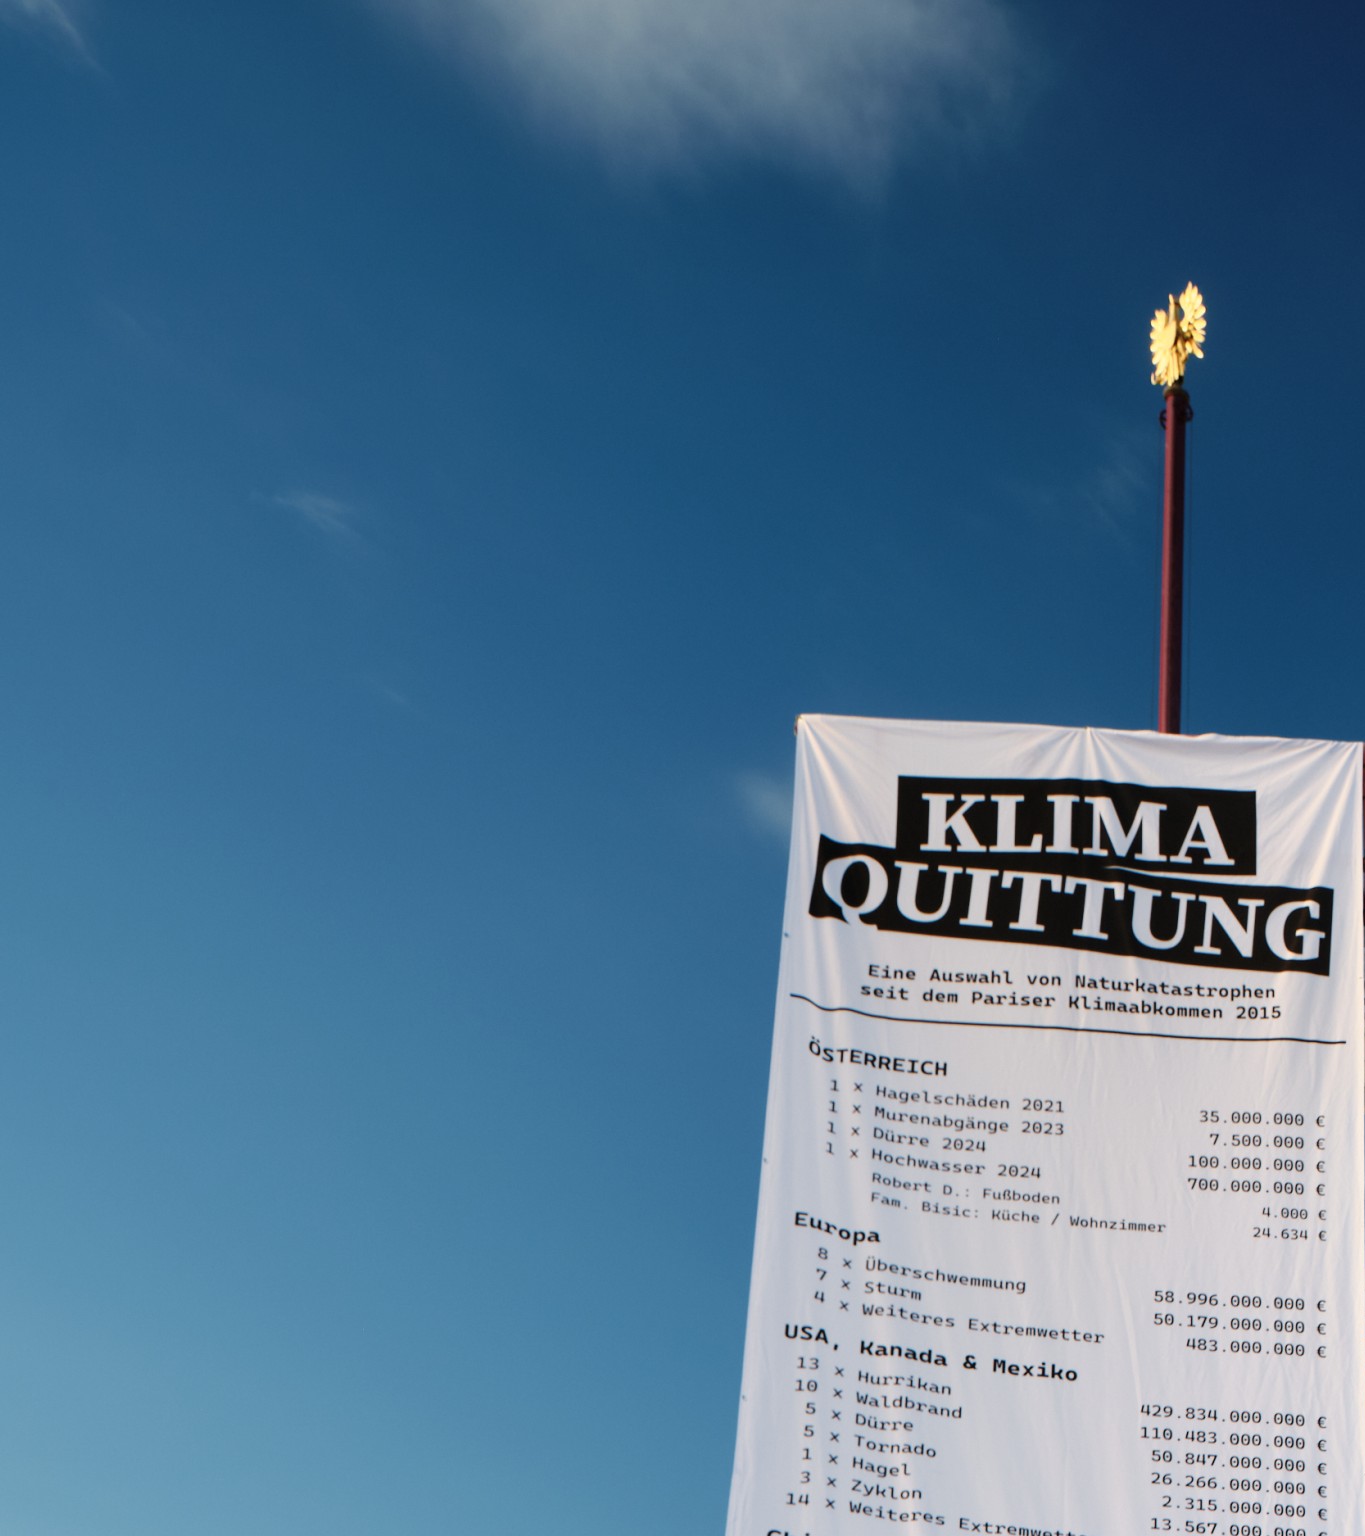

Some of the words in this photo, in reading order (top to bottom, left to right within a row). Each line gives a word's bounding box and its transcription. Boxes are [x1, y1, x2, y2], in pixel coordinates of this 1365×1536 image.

[920, 793, 1235, 866] KLIMA
[821, 853, 1327, 962] QUITTUNG
[867, 963, 917, 981] Eine
[929, 968, 1013, 985] Auswahl
[1026, 974, 1062, 987] von
[1074, 974, 1276, 1000] Naturkatastrophen
[859, 984, 911, 1003] seit
[921, 988, 959, 1004] dem
[971, 990, 1056, 1008] Pariser
[1068, 994, 1223, 1019] Klimaabkommen
[1235, 1005, 1282, 1020] 2015
[808, 1036, 948, 1077] ÖSTERREICH
[830, 1078, 839, 1093] 1
[875, 1084, 1010, 1110] Hagelschäden
[1021, 1097, 1065, 1114] 2021
[829, 1100, 838, 1114] 1
[873, 1105, 1010, 1135] Murenabgänge
[1021, 1120, 1065, 1136] 2023
[1199, 1109, 1305, 1127] 35.000.000
[1315, 1114, 1325, 1128] €
[827, 1121, 836, 1135] 1
[872, 1126, 930, 1148] Dürre
[942, 1137, 987, 1153] 2024
[1209, 1132, 1305, 1150] 7.500.000
[1315, 1137, 1326, 1151] €
[826, 1141, 835, 1156] 1
[871, 1147, 986, 1175] Hochwasser
[997, 1163, 1042, 1180] 2024
[1188, 1154, 1305, 1173] 100.000.000
[1315, 1160, 1326, 1174] €
[871, 1171, 931, 1193] Robert
[982, 1187, 1061, 1205] Fußboden
[1186, 1177, 1305, 1196] 700.000.000
[1315, 1183, 1326, 1197] €
[795, 1212, 880, 1246] Europa
[991, 1208, 1041, 1224] Küche
[1050, 1212, 1061, 1226] /
[1068, 1215, 1167, 1234] Wohnzimmer
[1261, 1206, 1309, 1221] 4.000
[1317, 1209, 1327, 1221] €
[1252, 1226, 1309, 1241] 24.634
[1317, 1229, 1327, 1242] €
[815, 1267, 828, 1282] 7
[864, 1281, 923, 1302] Sturm
[817, 1246, 829, 1261] 8
[866, 1259, 1026, 1294] Überschwemmung
[813, 1290, 825, 1304] 4
[861, 1303, 956, 1328] Weiteres
[967, 1317, 1105, 1344] Extremwetter
[1153, 1289, 1306, 1311] 58.996.000.000
[1316, 1299, 1327, 1313] €
[1153, 1312, 1306, 1334] 50.179.000.000
[1316, 1322, 1327, 1336] €
[784, 1323, 839, 1351] USA,
[859, 1339, 948, 1367] Kanada
[962, 1354, 977, 1371] &
[992, 1357, 1078, 1382] Mexiko
[1185, 1337, 1306, 1357] 483.000.000
[1316, 1345, 1327, 1359] €
[797, 1356, 820, 1371] 13
[857, 1369, 952, 1396] Hurrikan
[795, 1378, 819, 1393] 10
[855, 1391, 963, 1420] Waldbrand
[804, 1401, 817, 1415] 5
[854, 1412, 914, 1432] Dürre
[1140, 1403, 1306, 1428] 429.834.000.000
[1316, 1415, 1327, 1429] €
[803, 1424, 815, 1438] 5
[854, 1434, 937, 1459] Tornado
[1140, 1426, 1306, 1450] 110.483.000.000
[1316, 1438, 1327, 1453] €
[802, 1447, 812, 1461] 1
[851, 1456, 910, 1478] Hagel
[1151, 1449, 1306, 1473] 50.847.000.000
[1316, 1462, 1327, 1476] €
[800, 1470, 811, 1484] 3
[850, 1478, 923, 1500] Zyklon
[1150, 1471, 1306, 1496] 26.266.000.000
[1316, 1484, 1328, 1499] €
[786, 1492, 810, 1506] 14
[848, 1500, 946, 1526] Weiteres
[1161, 1495, 1307, 1518] 2.315.000.000
[1317, 1507, 1328, 1522] €
